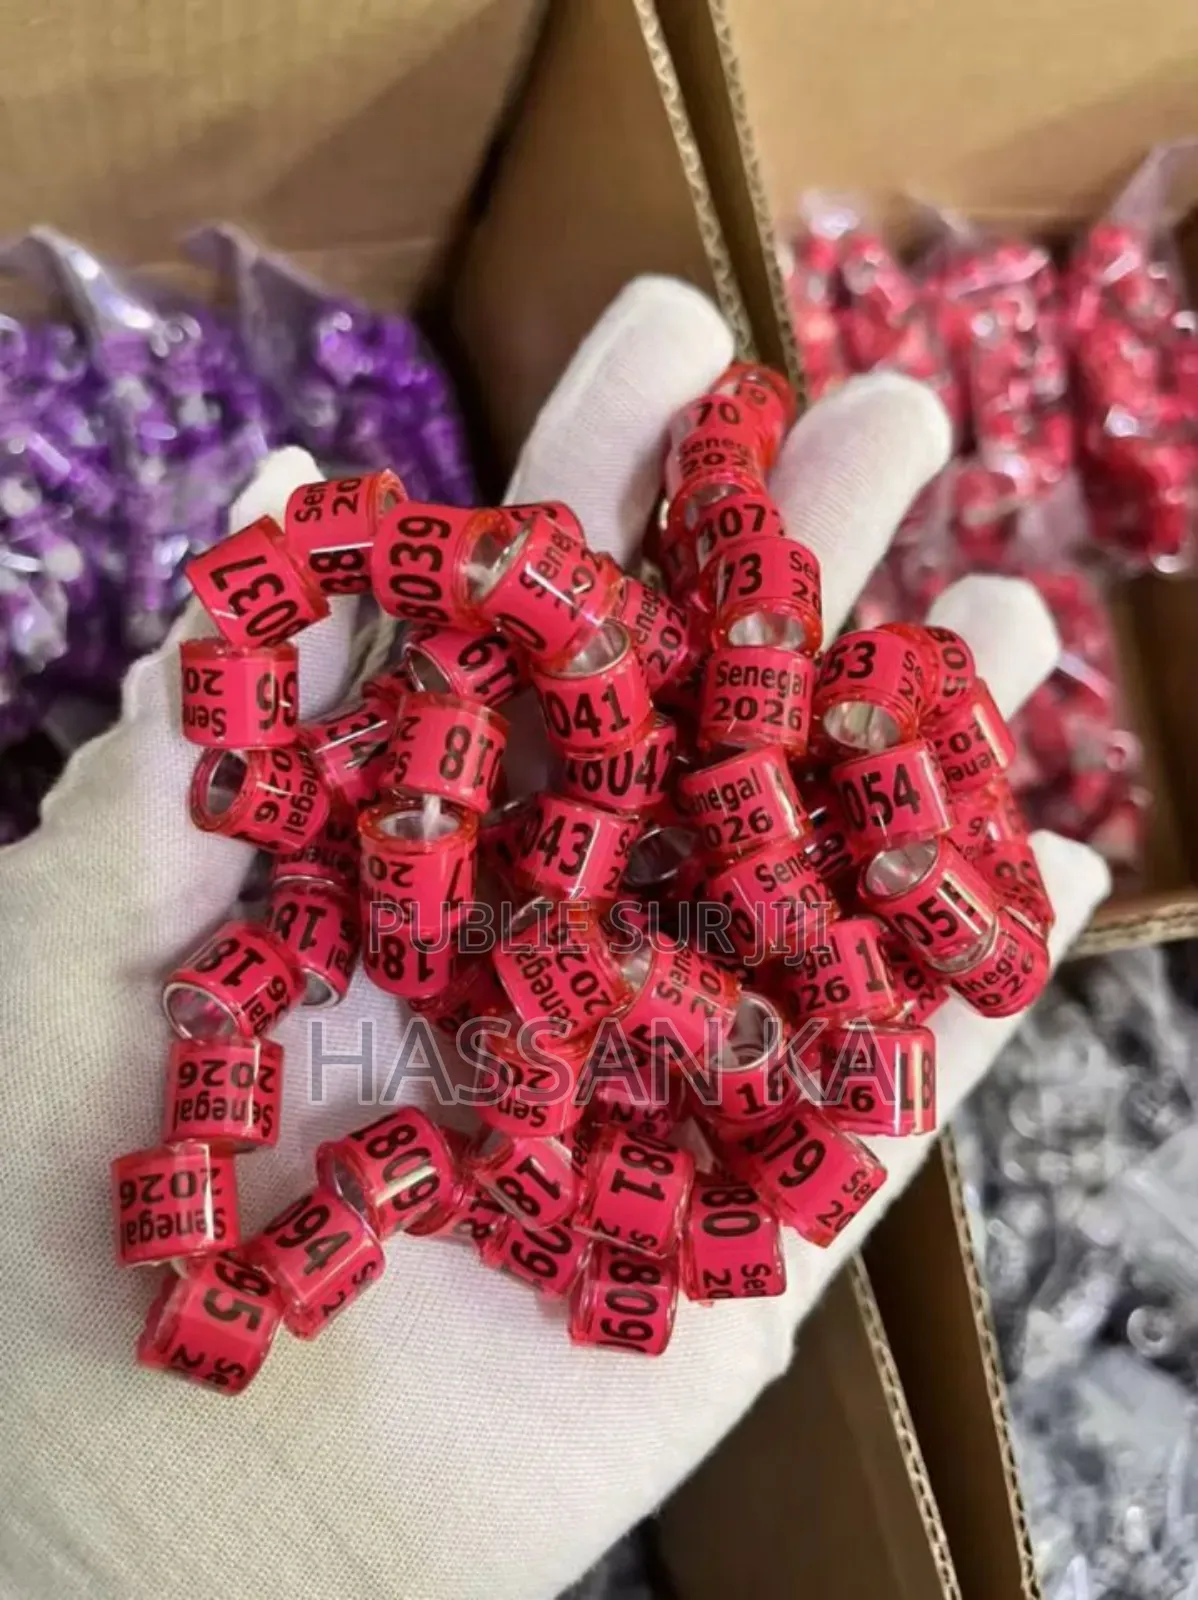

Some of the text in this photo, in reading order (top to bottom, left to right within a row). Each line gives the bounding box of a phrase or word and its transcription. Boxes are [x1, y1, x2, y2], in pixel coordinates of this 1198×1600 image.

[716, 659, 809, 699] Senegal
[712, 695, 803, 732] 2026
[177, 1060, 276, 1094] 2026
[172, 1091, 275, 1139] Senegal
[119, 1167, 221, 1210] 2026
